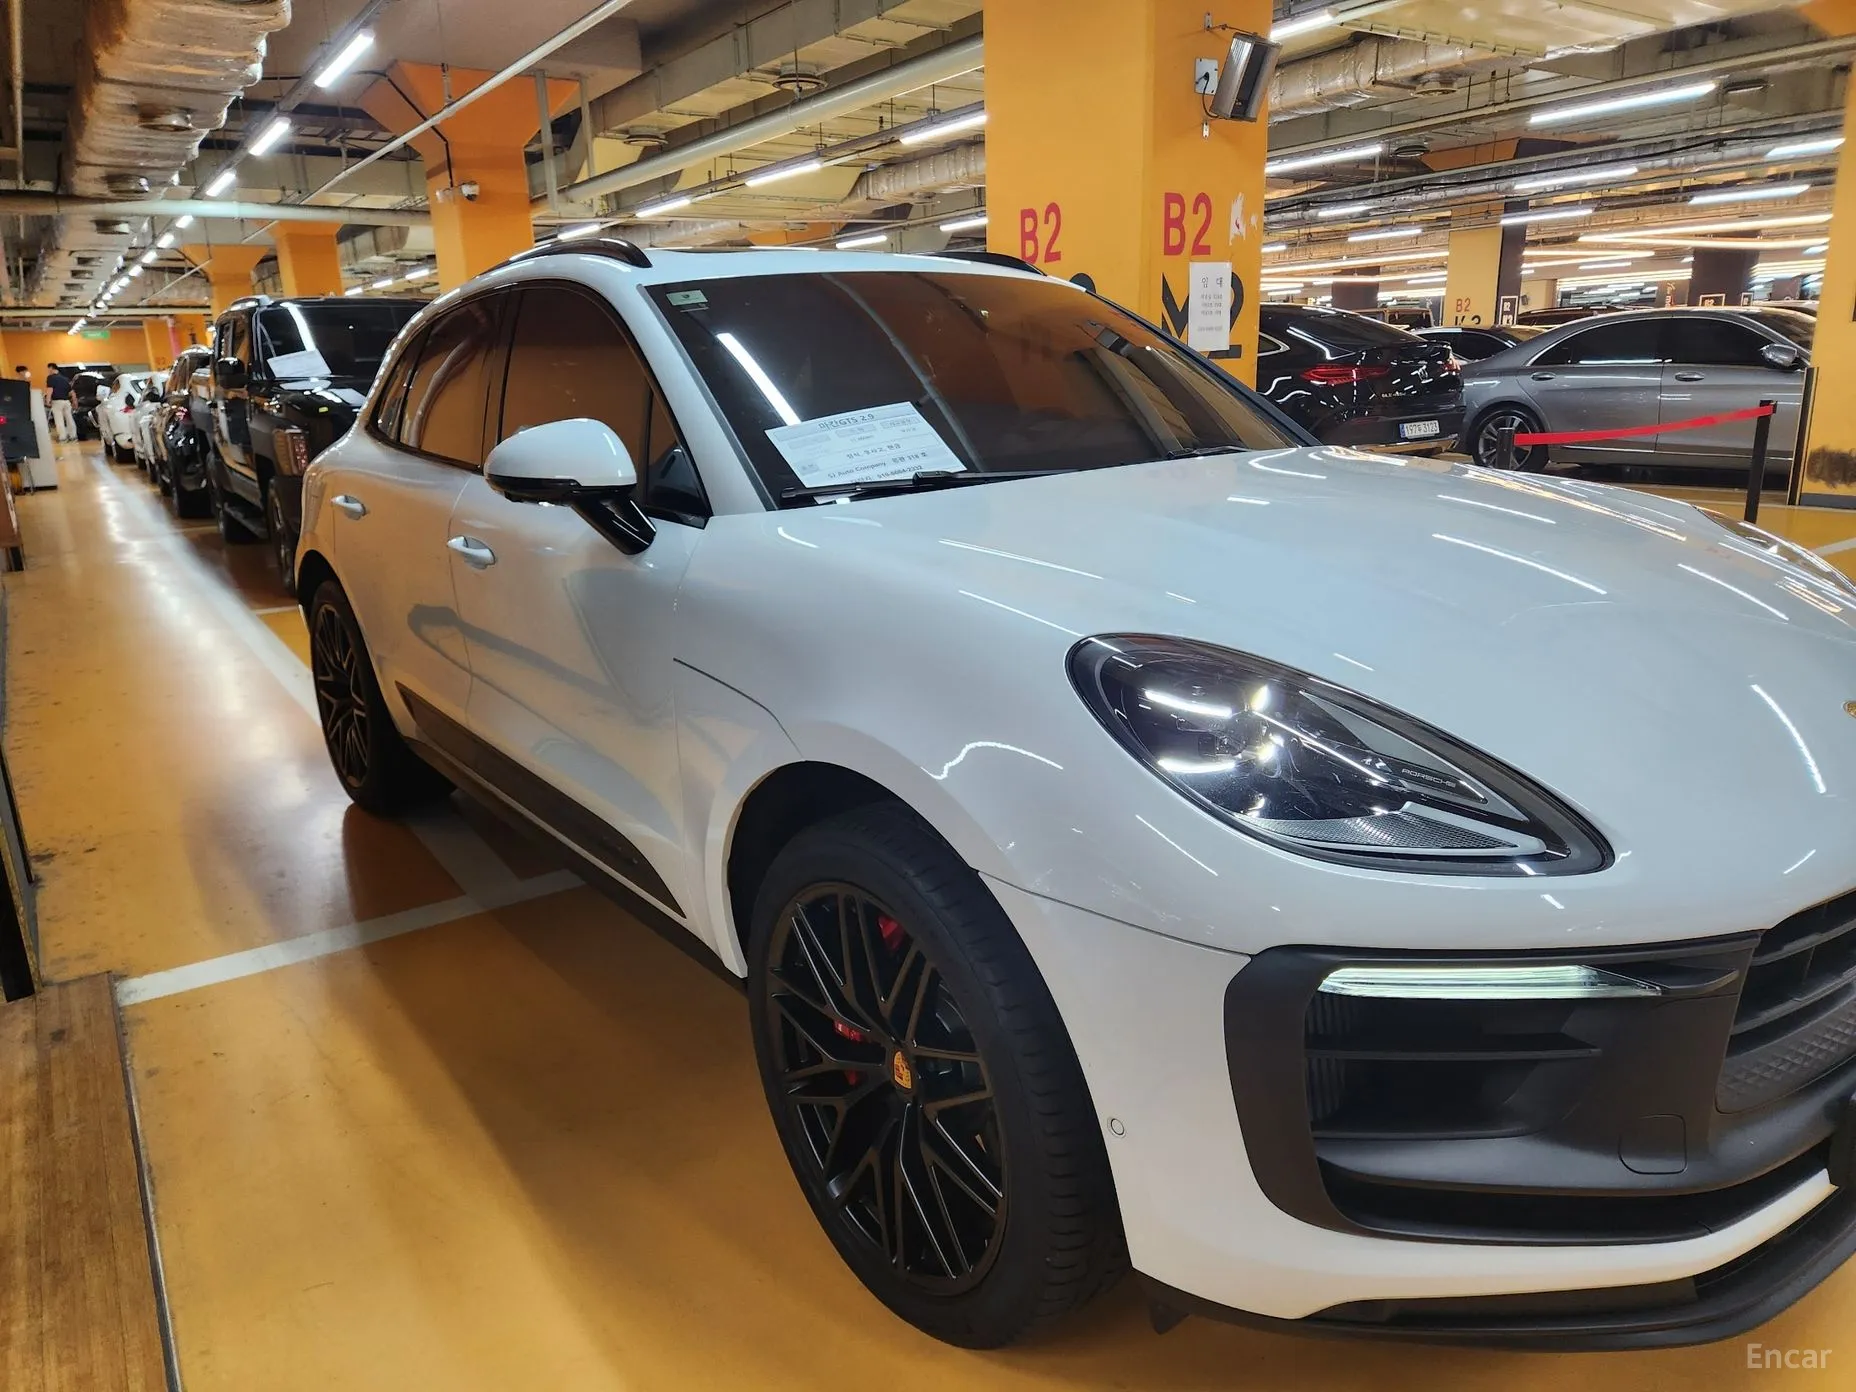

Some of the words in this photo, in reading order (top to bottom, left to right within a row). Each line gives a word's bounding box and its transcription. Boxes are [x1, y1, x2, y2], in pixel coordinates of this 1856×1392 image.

[1020, 202, 1062, 265] B2
[1163, 192, 1212, 256] B2
[1456, 298, 1471, 312] B2
[860, 413, 875, 424] 2.9
[1401, 768, 1456, 788] PORSCHE
